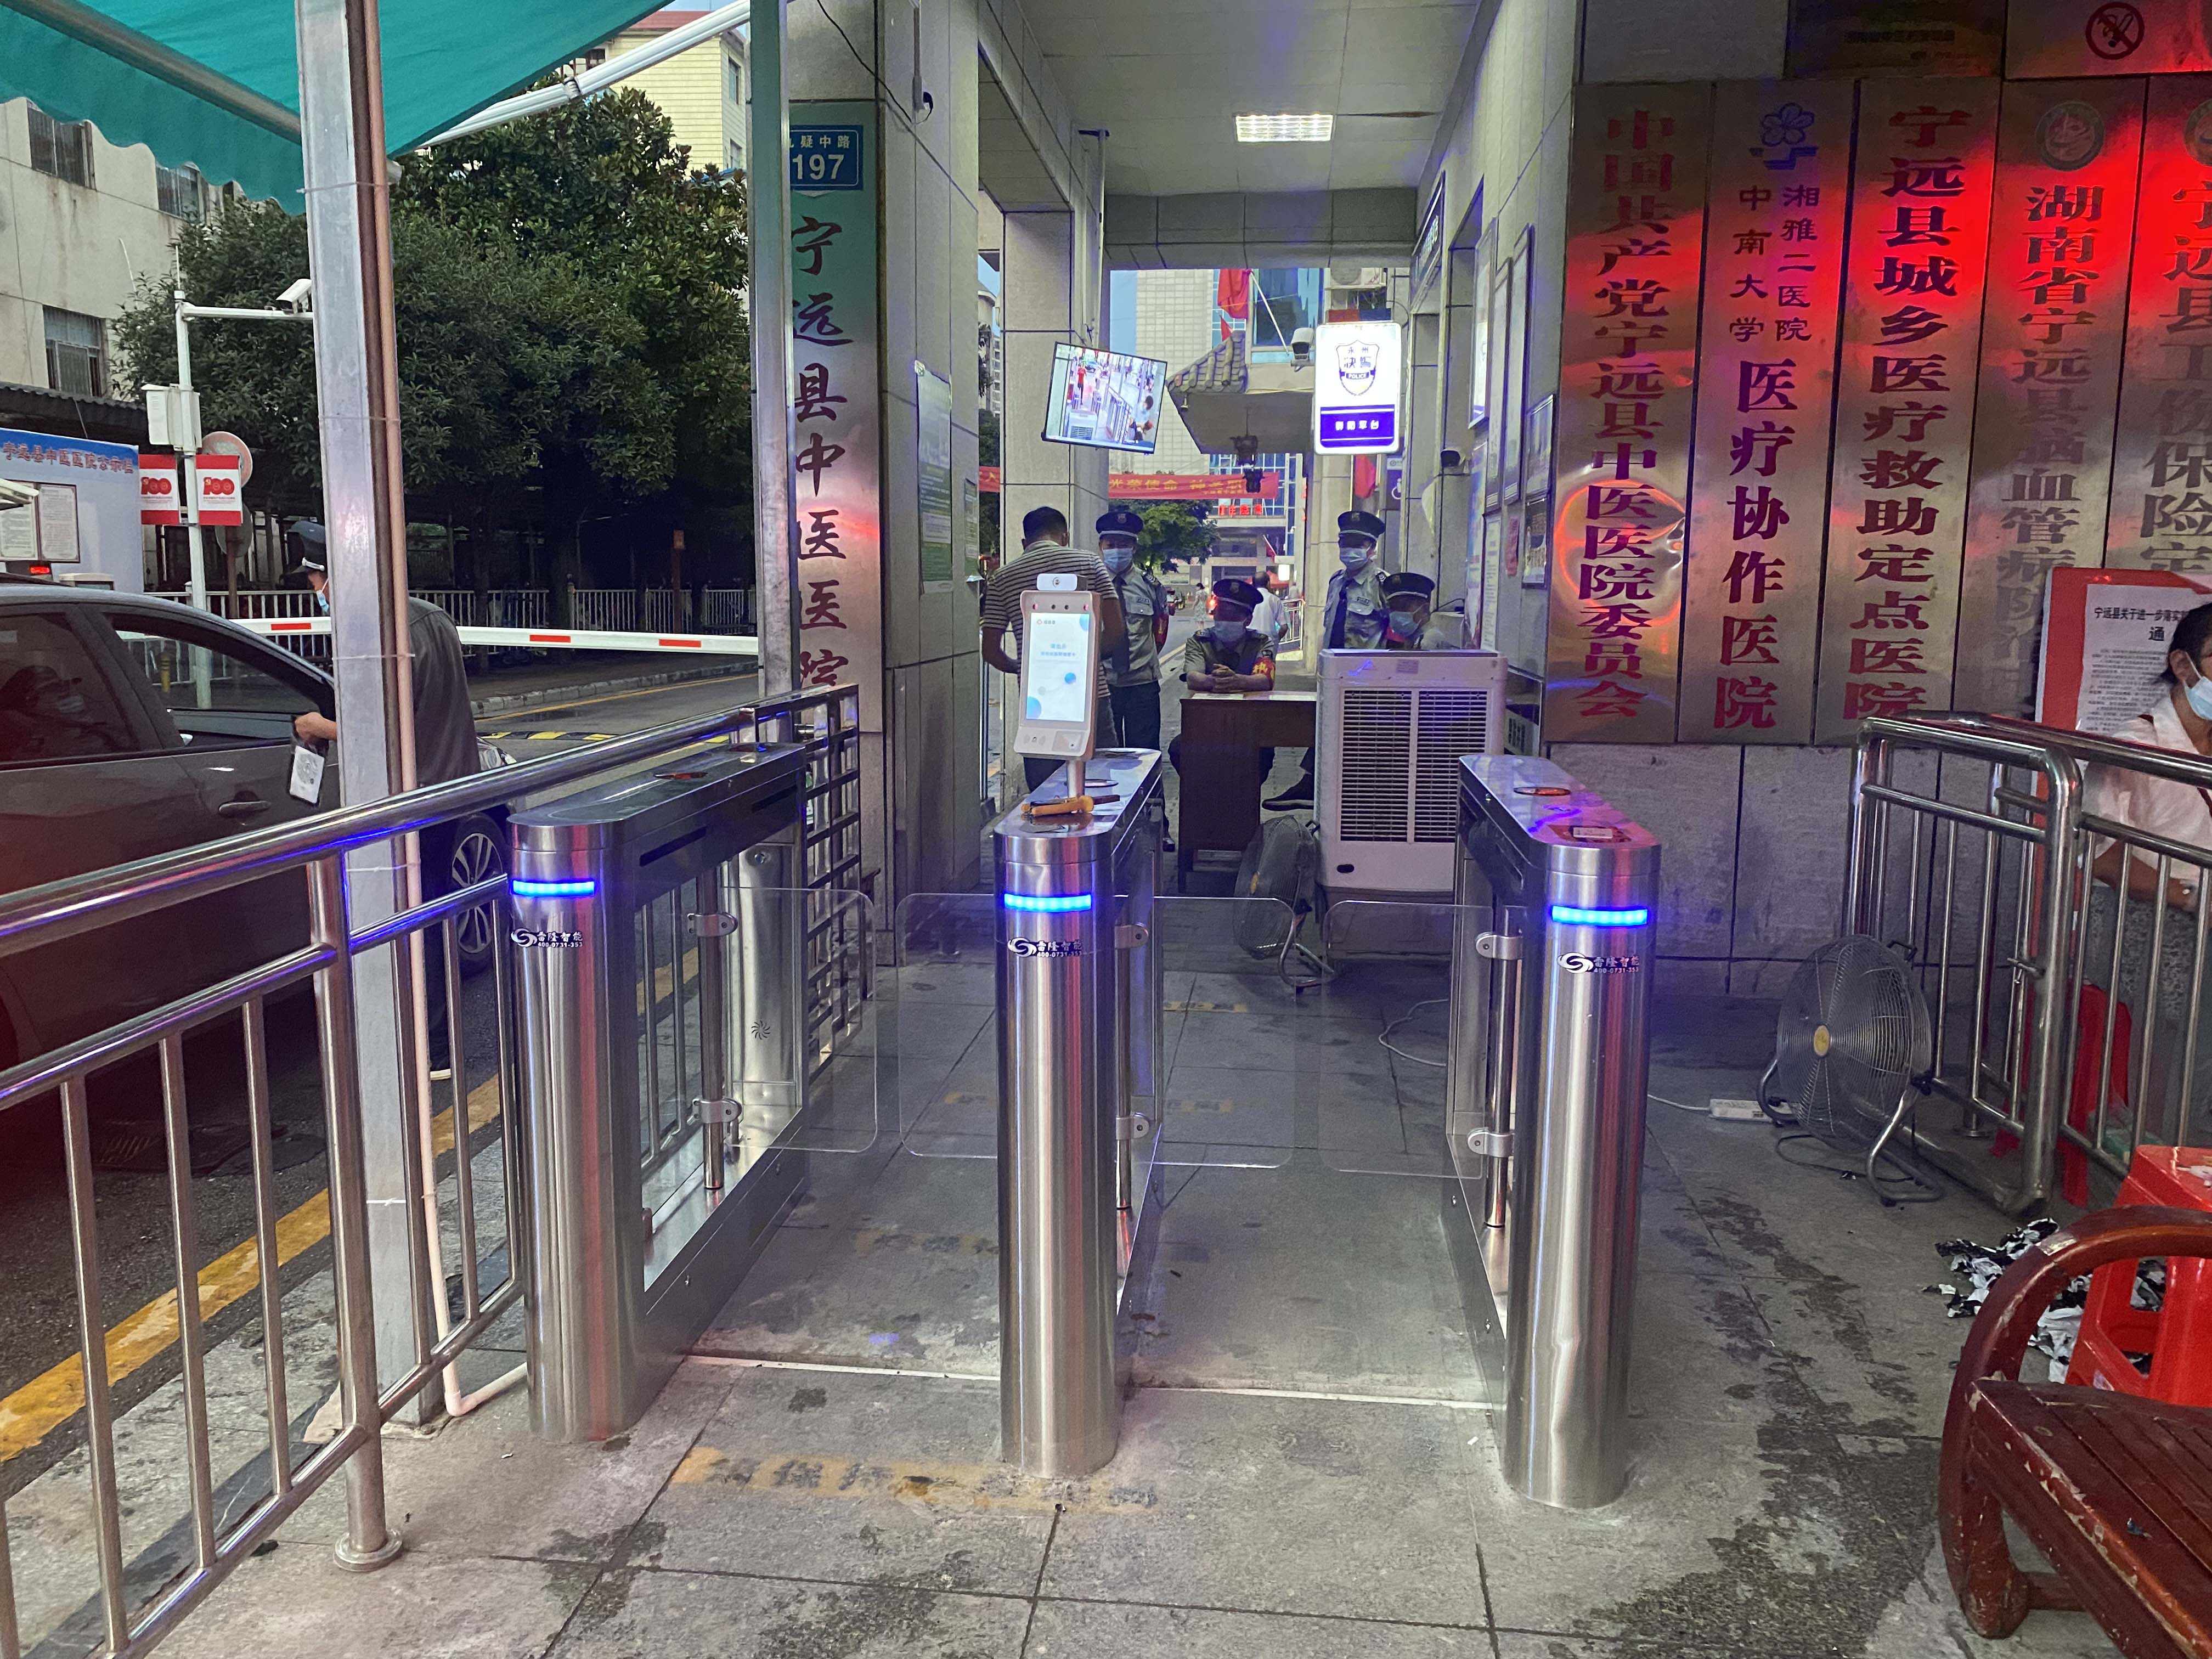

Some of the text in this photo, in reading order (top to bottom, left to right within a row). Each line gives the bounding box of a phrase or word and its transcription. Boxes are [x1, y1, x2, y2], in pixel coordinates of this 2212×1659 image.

[792, 154, 844, 180] 197
[1729, 185, 1771, 342] 中南大学
[1775, 184, 1820, 342] 湘雅二医院
[1348, 346, 1369, 354] 永州
[1577, 110, 1676, 718] 中国共产党宁远县中医医院委员会
[1842, 105, 1971, 720] 宁远县城乡医疗救助定点医院
[791, 215, 854, 686] 宁远县中医医院
[1109, 478, 1177, 490] 光荣使命
[1713, 359, 1797, 729] 医疗协作医院
[2148, 626, 2165, 641] 通
